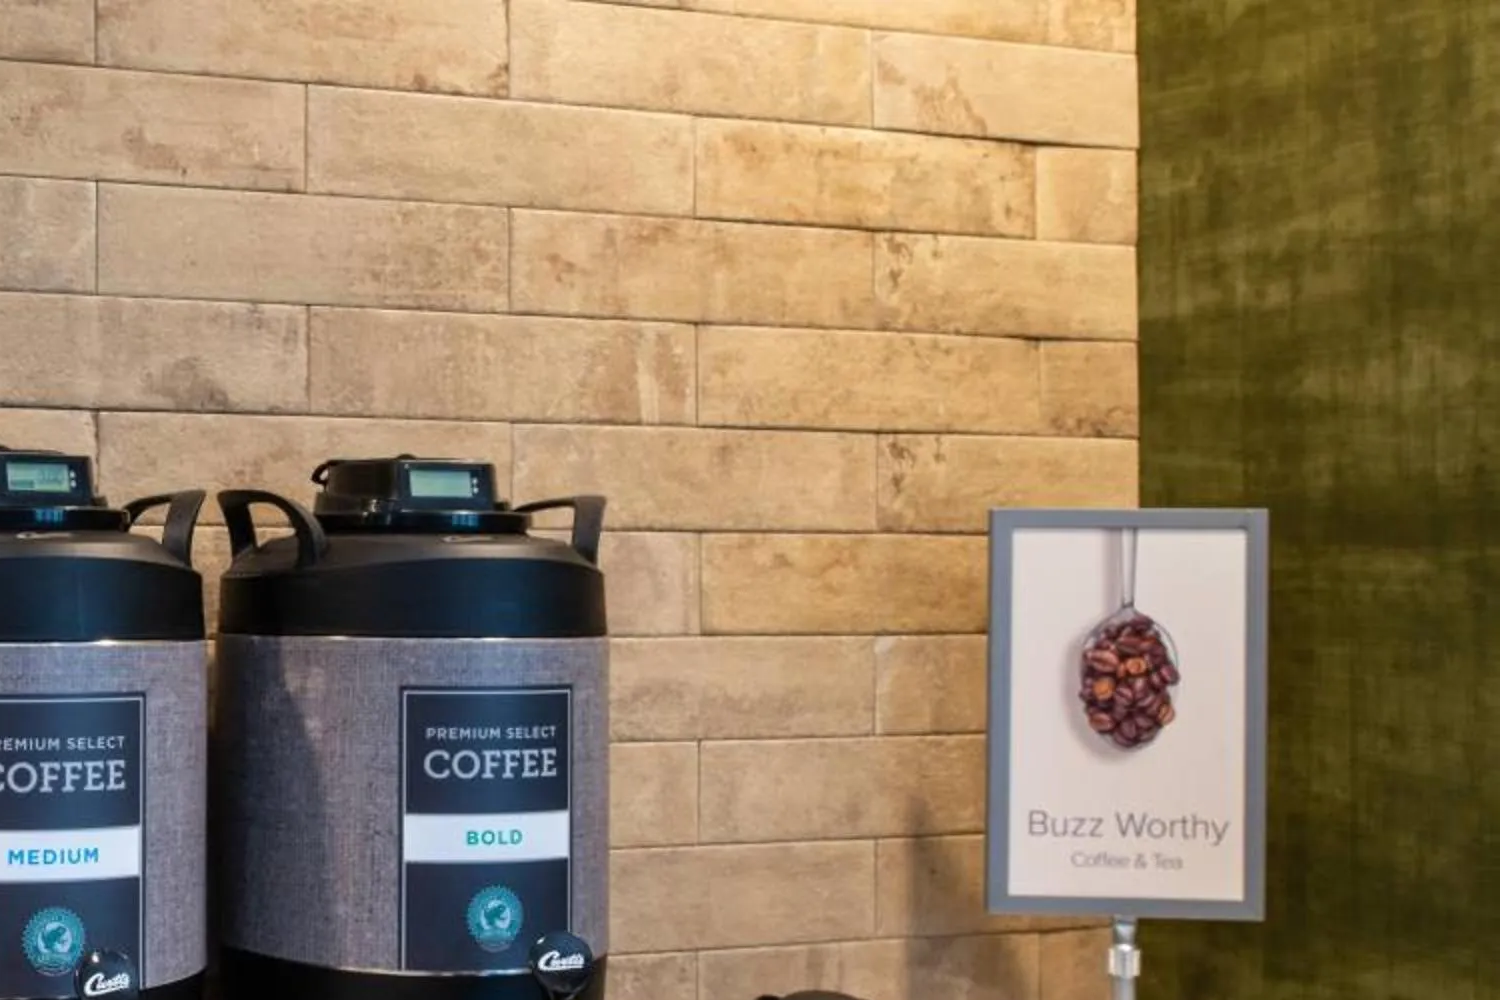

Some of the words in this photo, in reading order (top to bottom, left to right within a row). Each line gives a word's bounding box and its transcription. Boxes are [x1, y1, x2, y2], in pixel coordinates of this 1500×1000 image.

[67, 735, 125, 749] SELECT
[426, 727, 501, 740] PREMIUM
[506, 726, 556, 739] SELECT
[423, 748, 558, 779] COFFEE
[1028, 809, 1104, 838] Buzz
[1115, 811, 1230, 846] Worthy
[466, 829, 523, 845] BOLD
[7, 848, 99, 866] MEDIUM
[1070, 851, 1131, 868] Coffee
[1152, 854, 1184, 870] Tea
